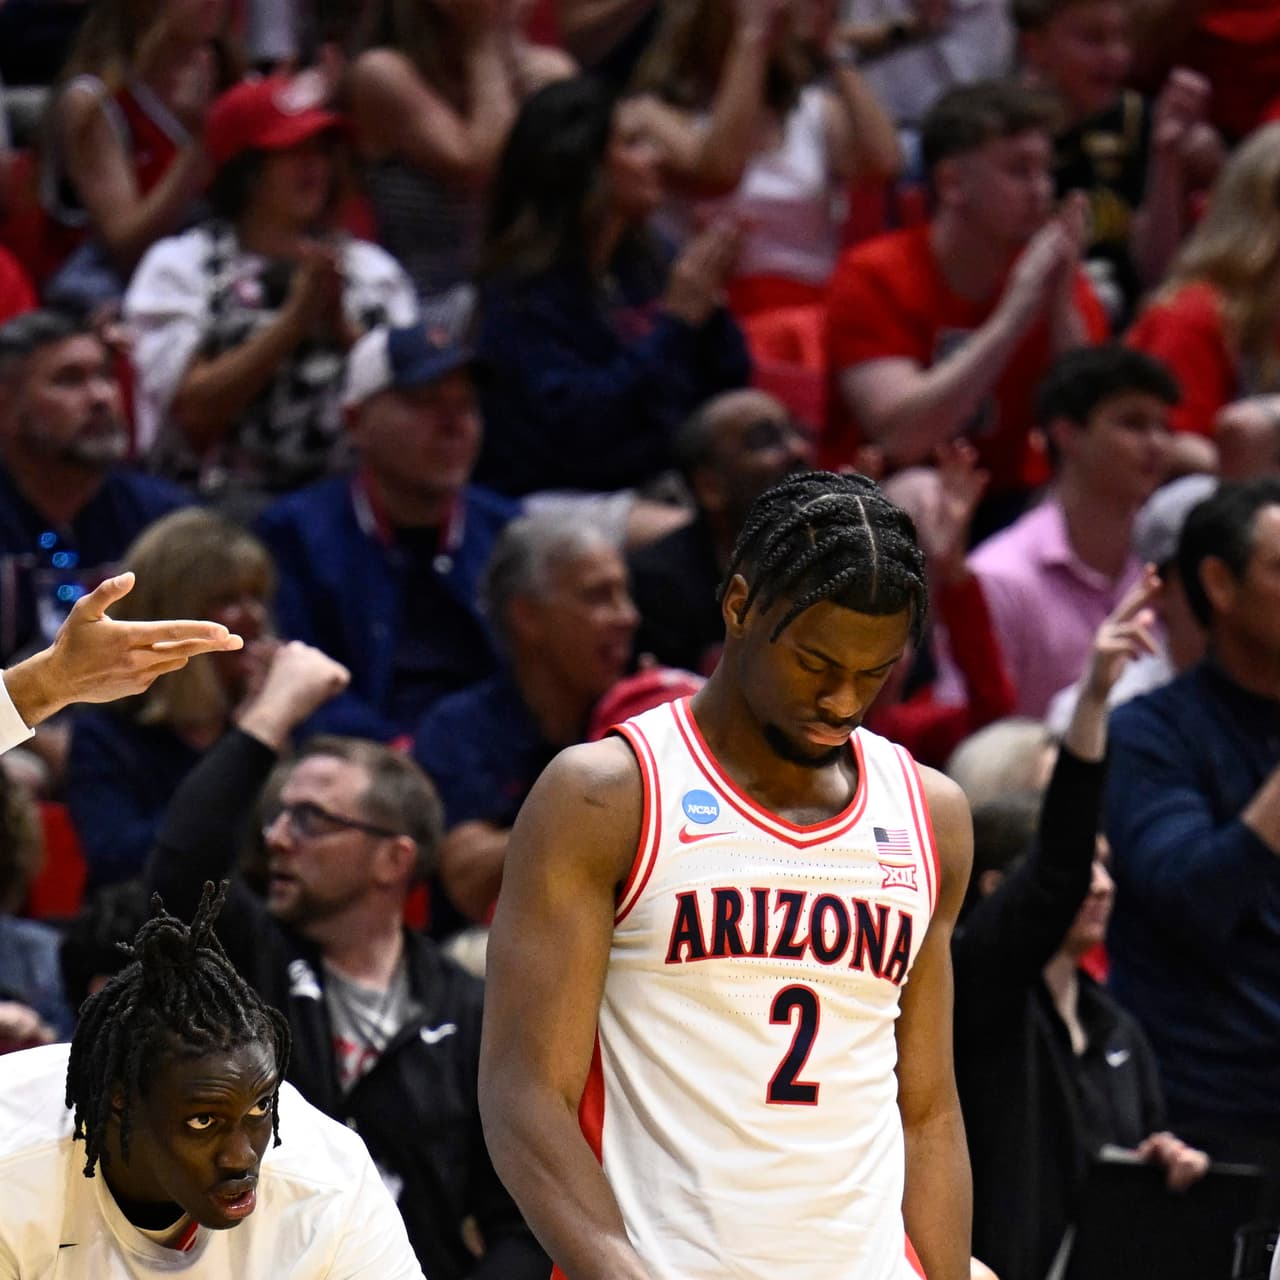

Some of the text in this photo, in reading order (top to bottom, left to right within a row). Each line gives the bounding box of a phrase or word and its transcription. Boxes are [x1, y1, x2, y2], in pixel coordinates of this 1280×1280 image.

[687, 804, 718, 816] NCAA
[665, 886, 914, 986] ARIZONA
[765, 983, 821, 1107] 2
